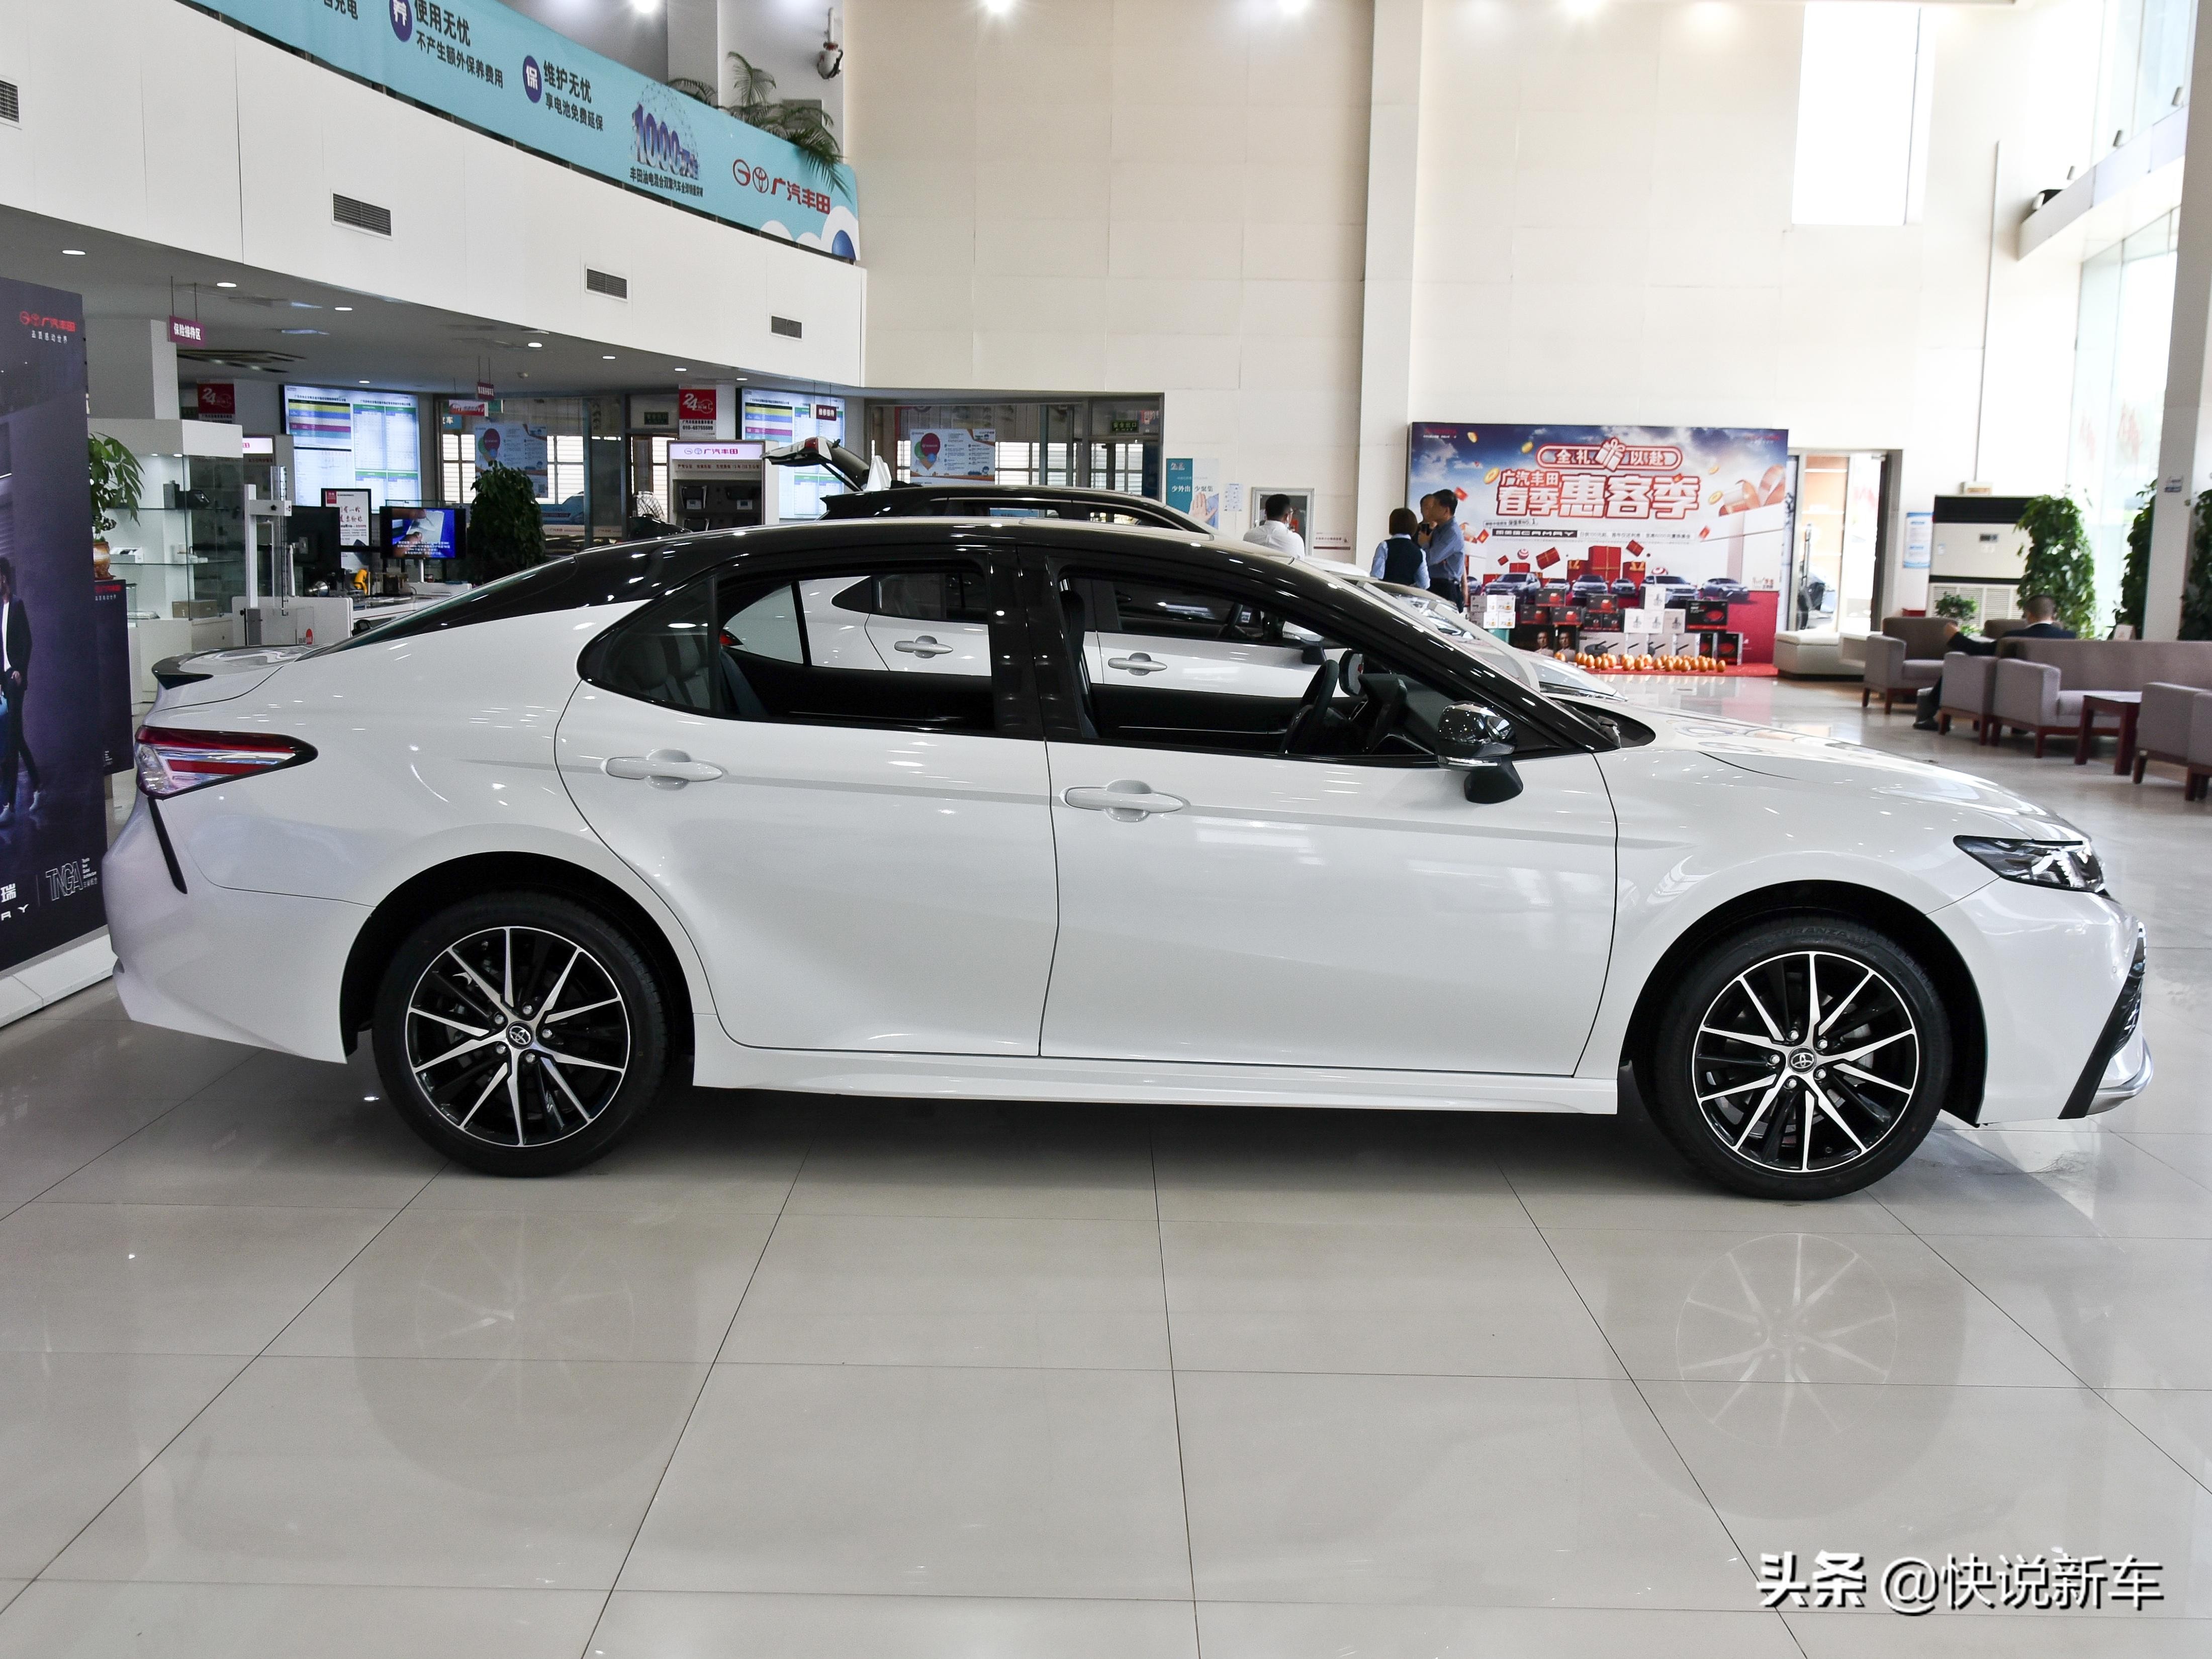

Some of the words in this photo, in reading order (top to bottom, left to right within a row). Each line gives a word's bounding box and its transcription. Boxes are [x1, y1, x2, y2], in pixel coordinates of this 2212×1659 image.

[414, 0, 471, 47] 使用无忧
[416, 30, 503, 88] 不产生额外保养费用
[526, 65, 538, 90] 保
[543, 60, 592, 104] 维护无忧
[545, 92, 603, 132] 享电池免费延保
[771, 178, 830, 215] 广汽丰田
[173, 322, 202, 340] 保险接待区
[1171, 485, 1191, 493] 少外出
[1501, 470, 1559, 486] 广汽丰田
[1559, 474, 1700, 519] 惠客季
[1497, 486, 1559, 516] 春季
[0, 883, 16, 902] 瑞
[45, 861, 83, 900] TNGA
